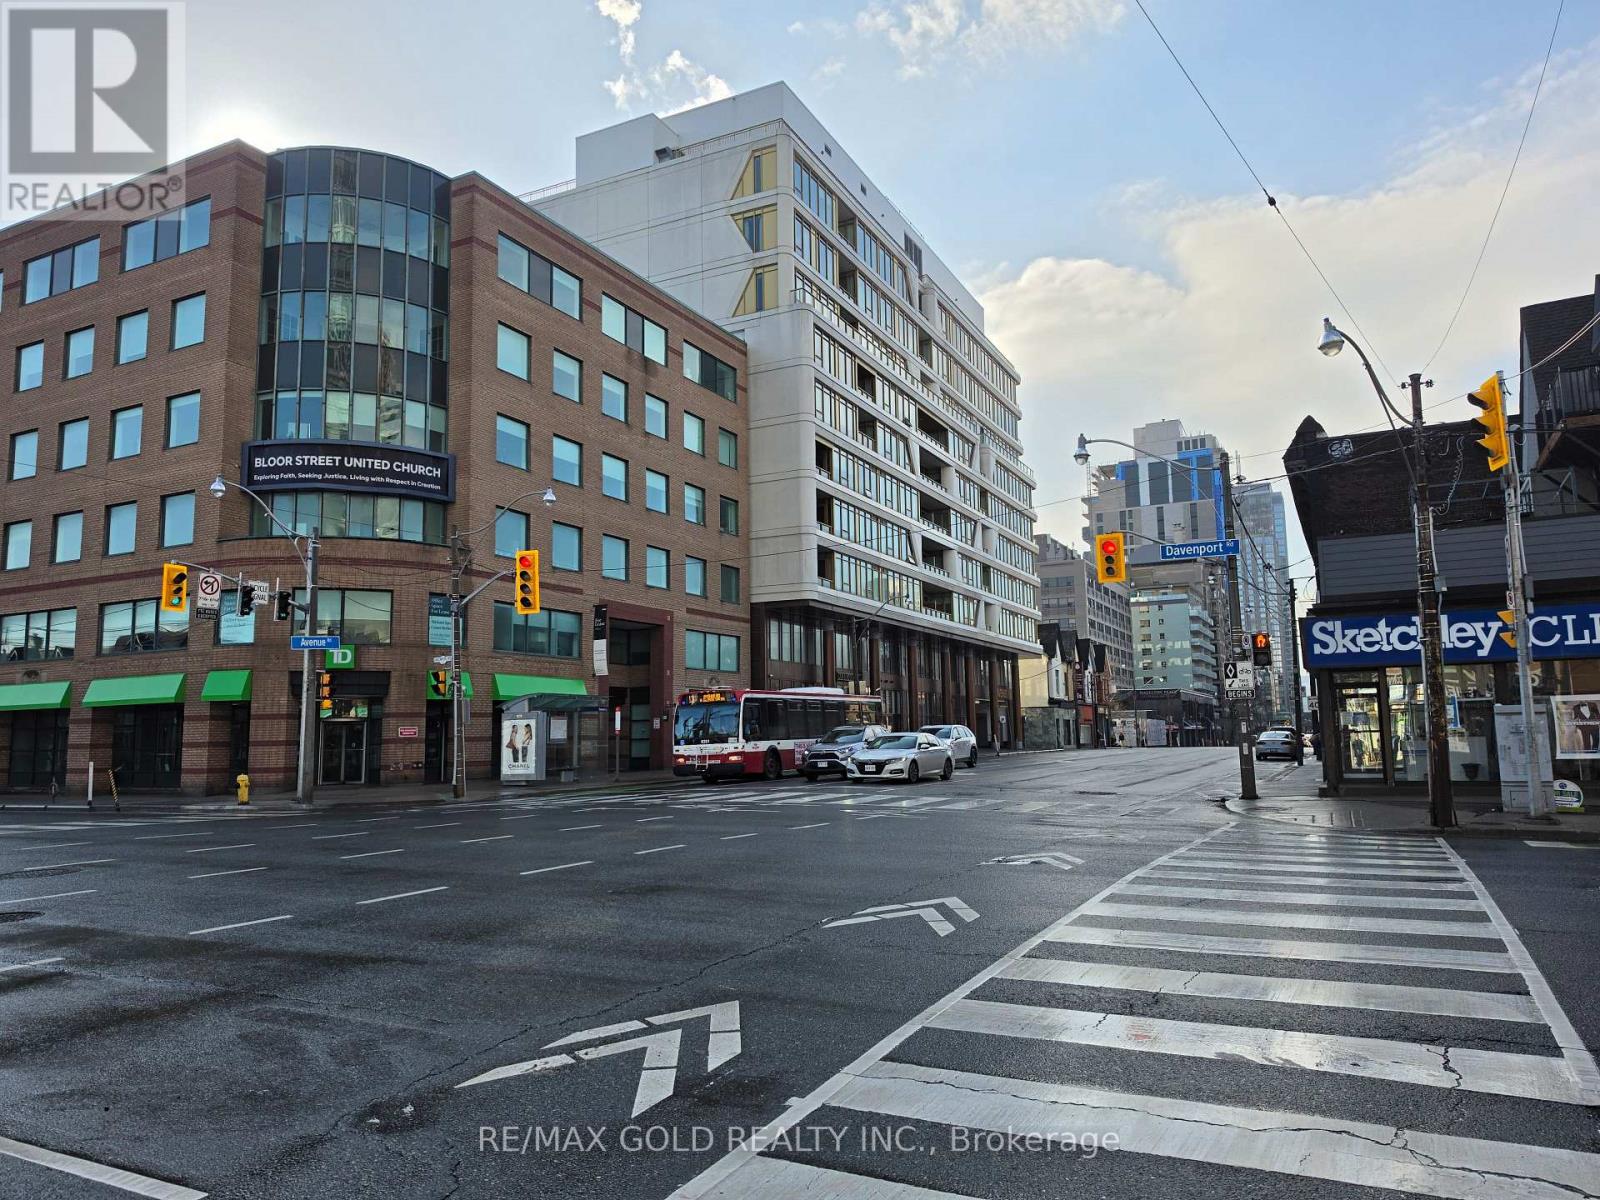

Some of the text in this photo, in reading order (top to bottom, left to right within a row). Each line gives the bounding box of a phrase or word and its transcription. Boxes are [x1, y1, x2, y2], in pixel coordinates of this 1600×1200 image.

[254, 455, 441, 478] BLOOR STREET UNITED CHURCH
[253, 473, 280, 481] Exploring
[297, 472, 322, 480] Seeking
[350, 474, 370, 482] Living
[385, 477, 410, 486] Respect
[417, 481, 441, 490] Creation
[1166, 542, 1223, 556] Davenport
[300, 637, 326, 647] Avenue
[1311, 614, 1503, 657] Sketcley
[328, 649, 352, 664] TD
[1227, 690, 1252, 698] BEGINS
